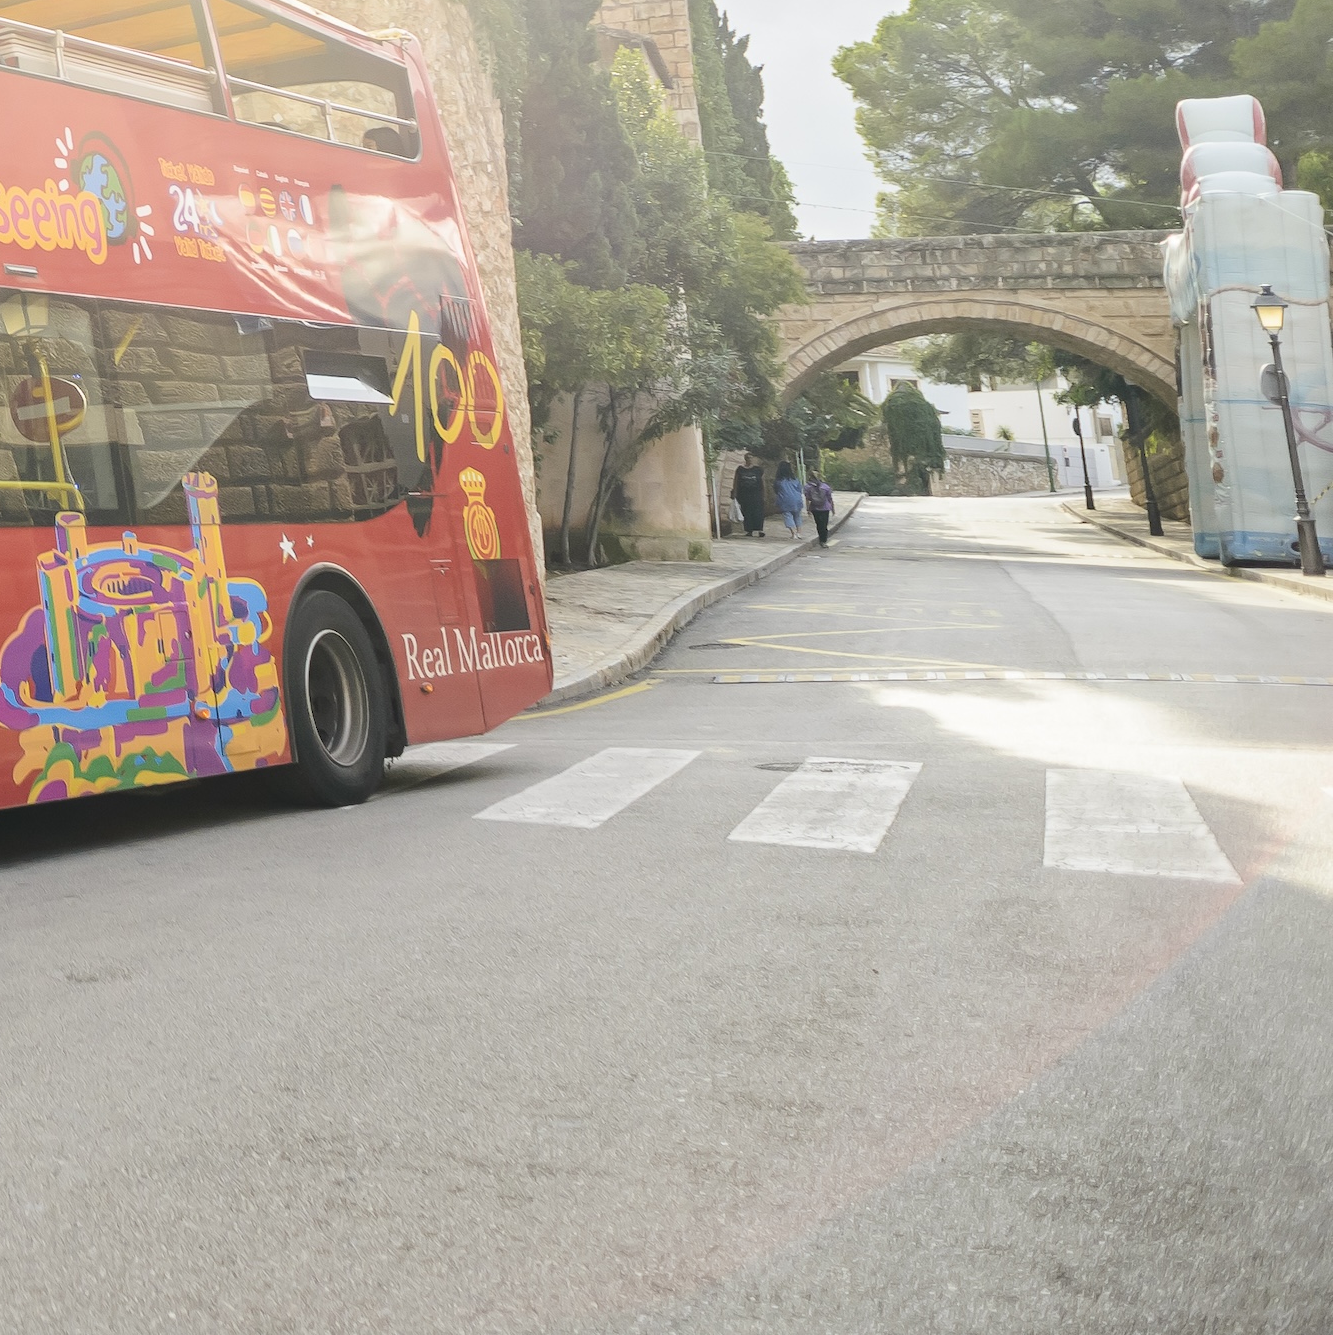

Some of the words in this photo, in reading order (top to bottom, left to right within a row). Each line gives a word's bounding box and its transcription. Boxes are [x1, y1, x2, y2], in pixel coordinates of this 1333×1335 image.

[168, 183, 201, 234] 24
[388, 308, 504, 464] 100
[401, 626, 454, 682] Real
[452, 626, 545, 674] Mallorca
